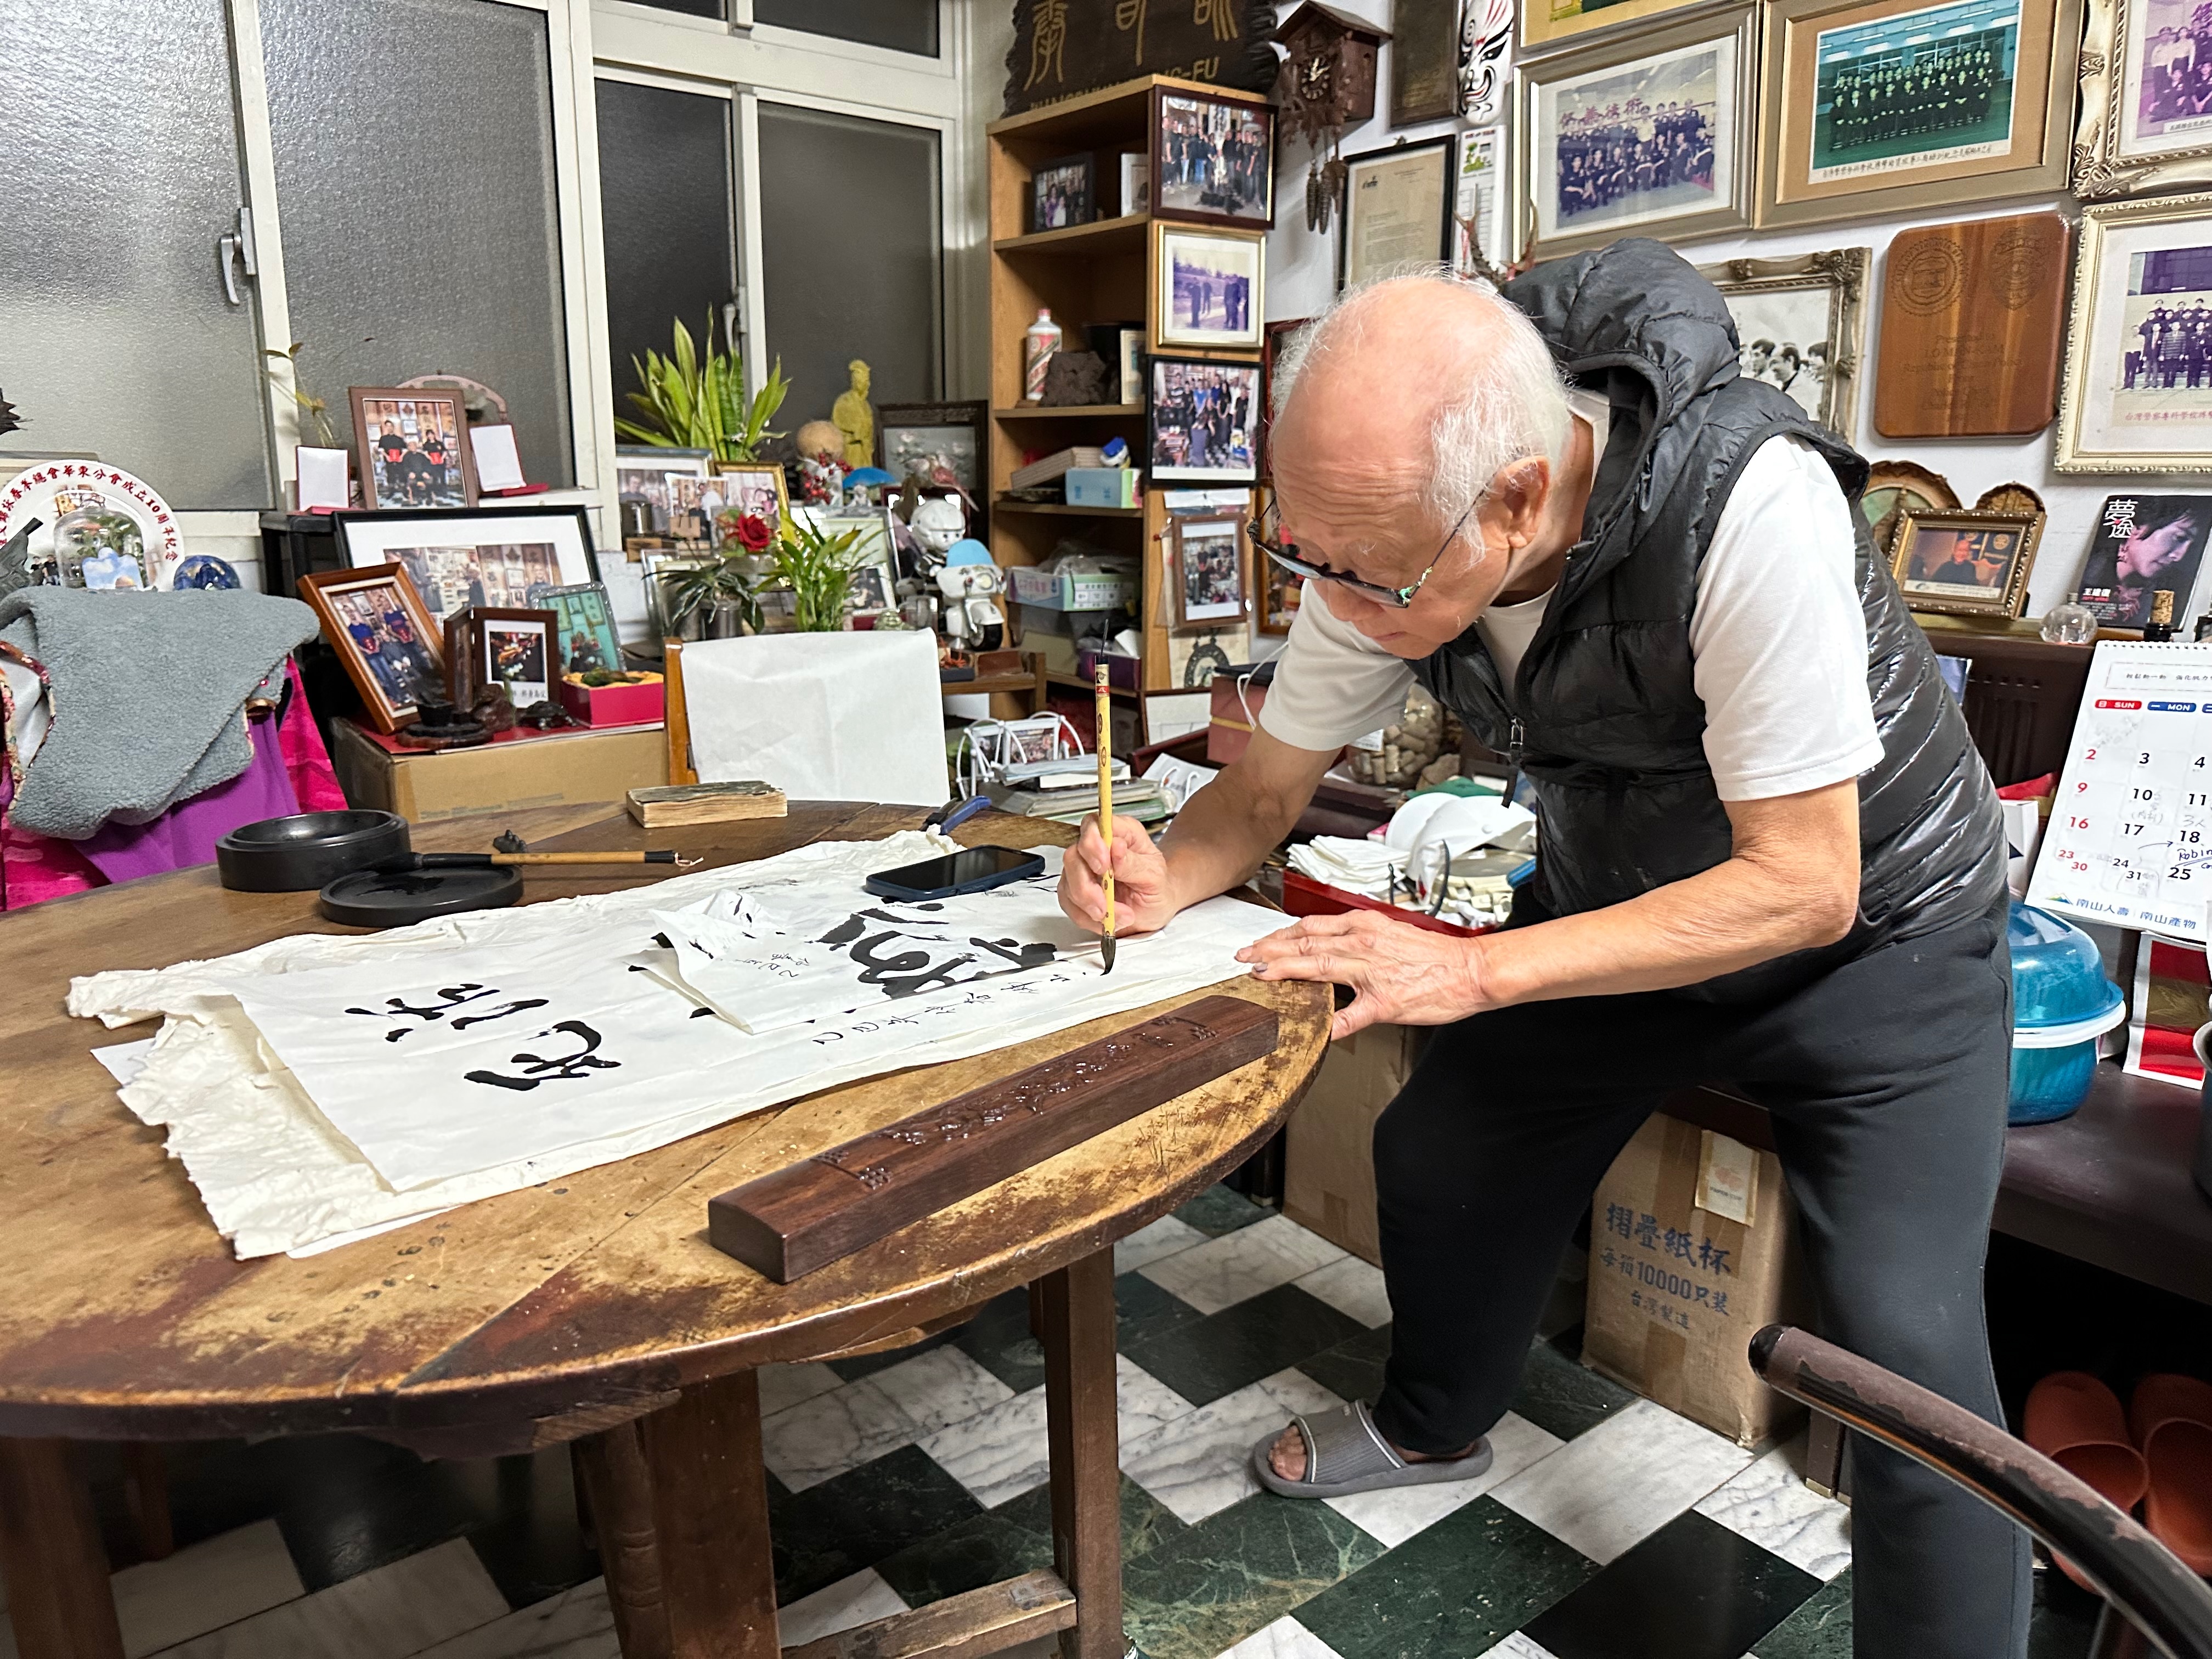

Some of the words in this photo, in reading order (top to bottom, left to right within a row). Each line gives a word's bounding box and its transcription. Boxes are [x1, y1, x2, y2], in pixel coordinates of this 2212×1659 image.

[2167, 703, 2191, 712] MON
[2085, 749, 2097, 760] 2
[2139, 753, 2150, 764] 3
[2194, 757, 2205, 768] 4
[2078, 782, 2088, 793] 9
[2133, 788, 2153, 800] 10
[2189, 793, 2207, 806] 11
[2070, 816, 2089, 829] 16
[2124, 823, 2145, 836] 17
[2180, 830, 2200, 843] 18
[2058, 849, 2074, 859] 23
[2113, 858, 2129, 868] 24
[2168, 867, 2191, 880] 25
[2071, 861, 2087, 871] 30
[2126, 871, 2142, 880] 31
[2076, 898, 2129, 916] 南山人壽
[2140, 911, 2196, 929] 南山產物
[1606, 1202, 1731, 1276] 摺疊紙杯
